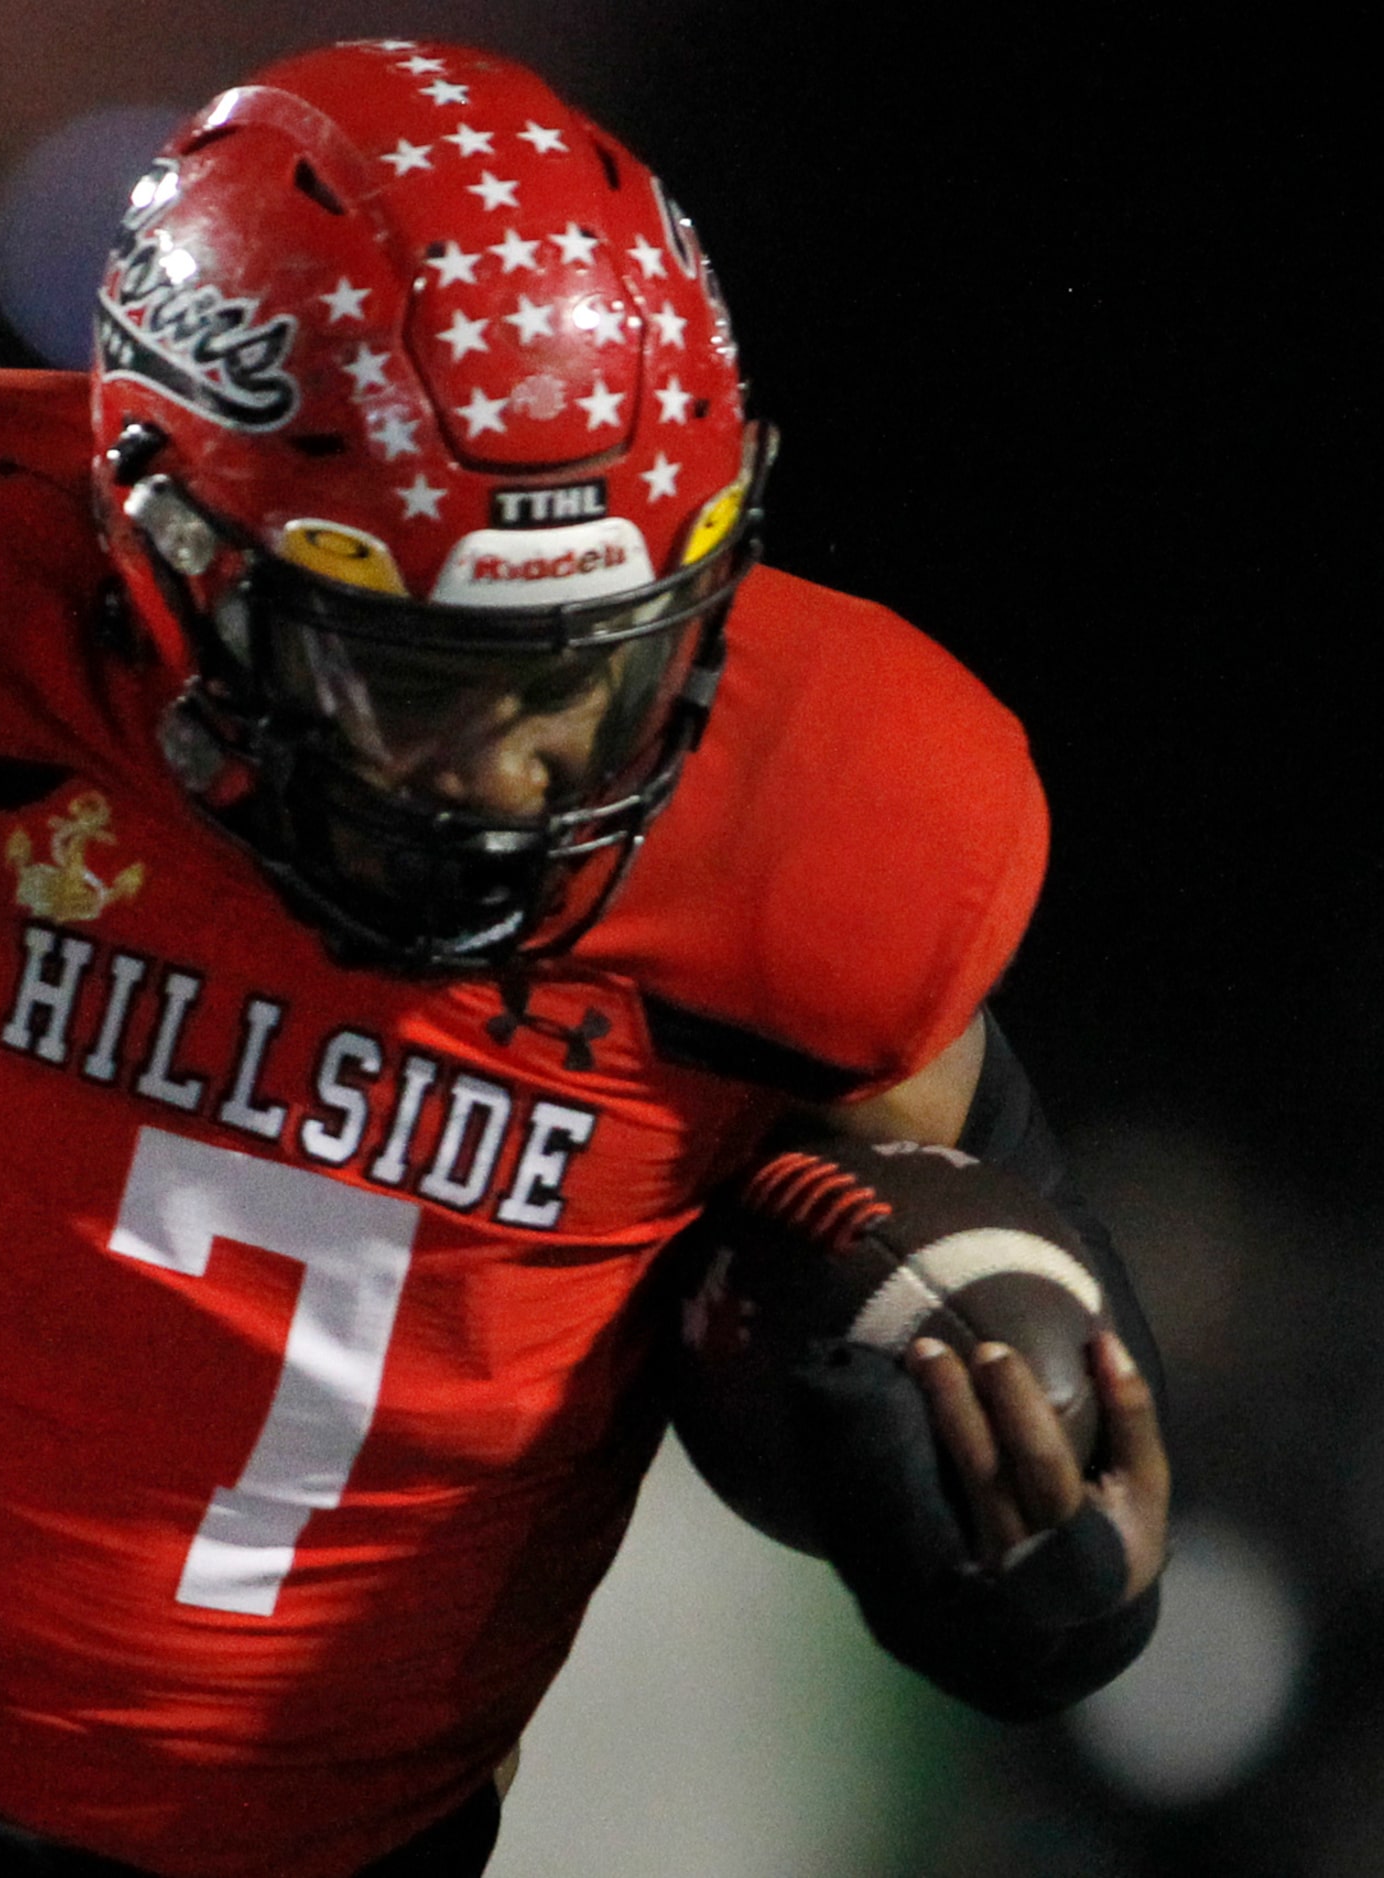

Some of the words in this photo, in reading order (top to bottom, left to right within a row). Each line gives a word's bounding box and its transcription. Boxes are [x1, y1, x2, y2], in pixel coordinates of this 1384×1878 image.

[496, 485, 606, 523] TTHL
[0, 927, 597, 1230] HILLSIDE
[109, 1125, 420, 1617] 7
